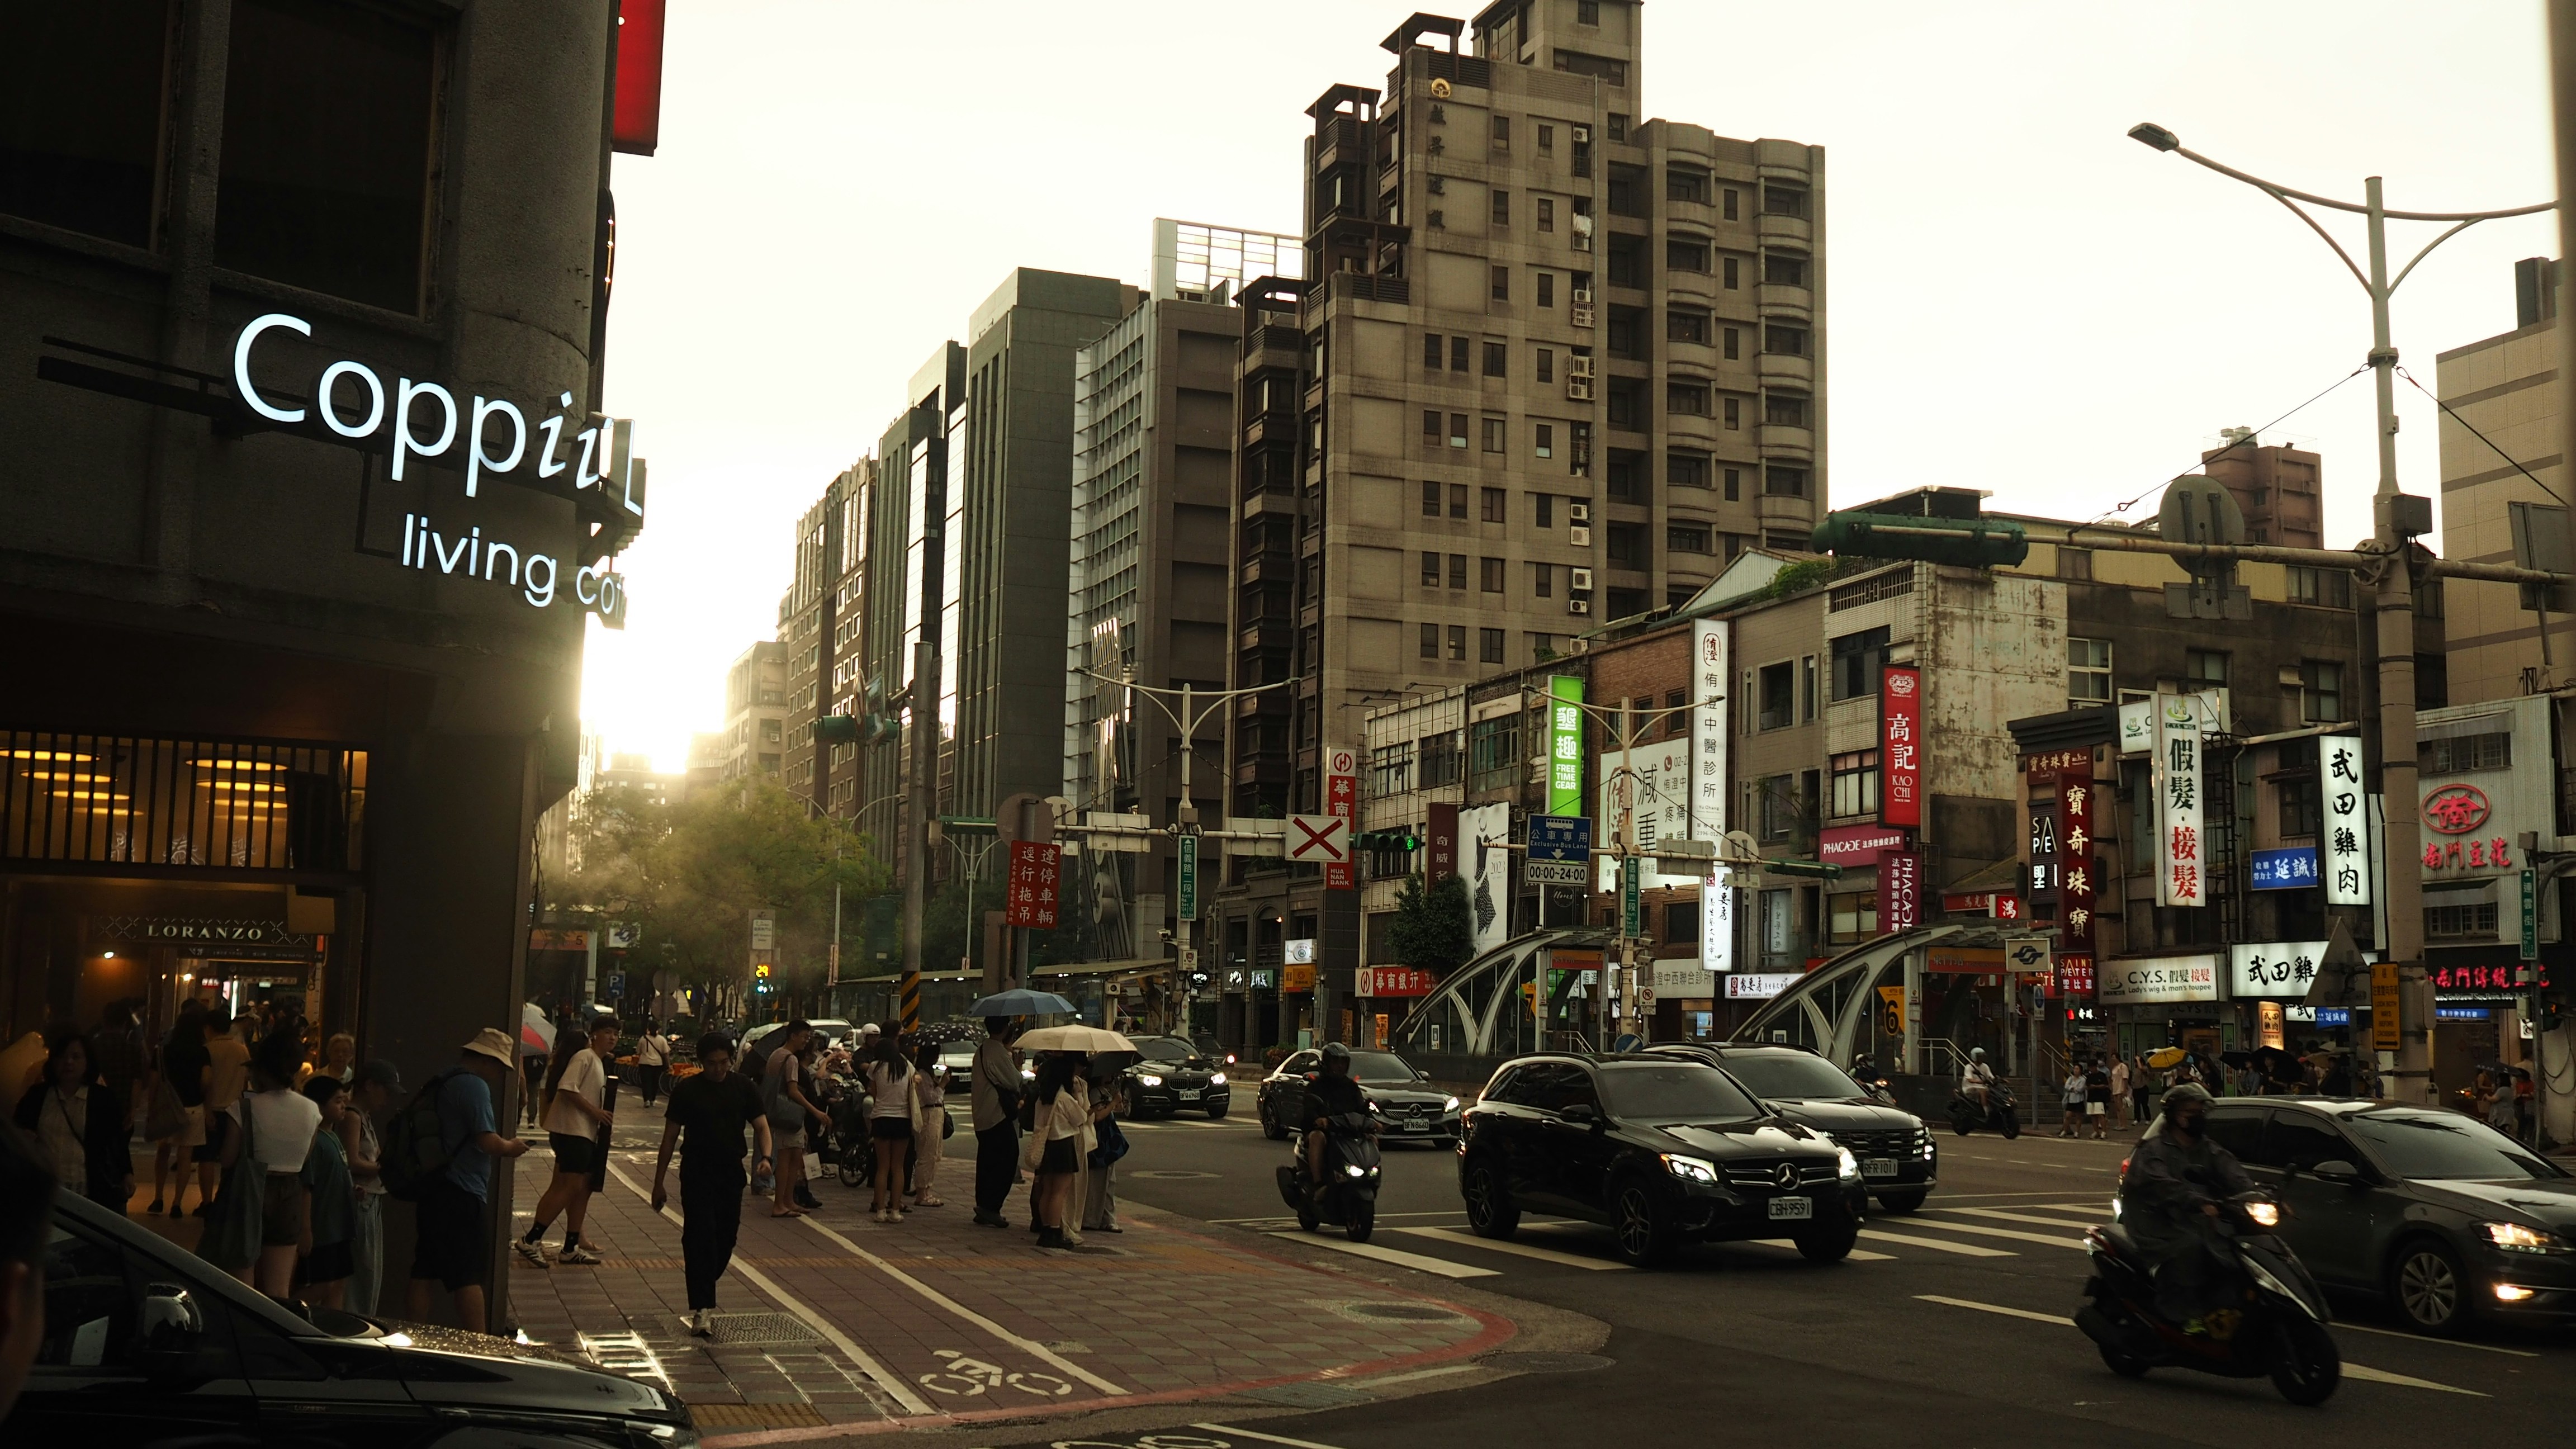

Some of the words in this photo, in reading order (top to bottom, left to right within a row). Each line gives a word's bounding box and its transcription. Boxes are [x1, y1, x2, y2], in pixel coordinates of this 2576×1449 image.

[402, 514, 557, 607] living
[1556, 707, 1577, 760] 墾趣
[1703, 673, 1718, 798] 侑澄中醫診所
[1887, 713, 1916, 770] 高記
[1556, 764, 1576, 773] FREE
[2030, 752, 2071, 772] 寶奇珠寶
[1555, 781, 1576, 790] GEAR
[1556, 773, 1576, 782] TIME
[1892, 775, 1912, 787] KAO
[1893, 787, 1911, 798] CHI
[1637, 764, 1657, 851] 減重
[2330, 748, 2359, 895] 武田雞肉
[1531, 829, 1588, 842] 公車專用
[1824, 840, 1860, 854] PHACADE
[2423, 837, 2511, 870] 南門豆花
[1183, 845, 1192, 893] 信義路二段
[1490, 861, 1506, 874] 2023
[2066, 784, 2090, 938] 寶奇珠寶
[1530, 866, 1585, 881] 00:00~24:00
[2253, 872, 2271, 880] 勞力士
[1019, 846, 1035, 923] 逕行拖吊
[1036, 847, 1057, 924] 違停車輛
[1628, 864, 1636, 911] 信義路二段
[2523, 882, 2534, 926] 連雲街
[148, 925, 262, 941] LORANZO
[576, 935, 584, 945] 5
[756, 965, 769, 977] 29
[2059, 959, 2093, 972] SAINT
[2060, 968, 2094, 977] PETER
[2248, 955, 2316, 986] 武田雞
[1376, 971, 1419, 992] 華南銀行
[2128, 970, 2166, 984] C.Y.S.
[2170, 969, 2189, 983] 假髮
[1525, 993, 1534, 1020] 7
[1885, 1000, 1899, 1035] 6
